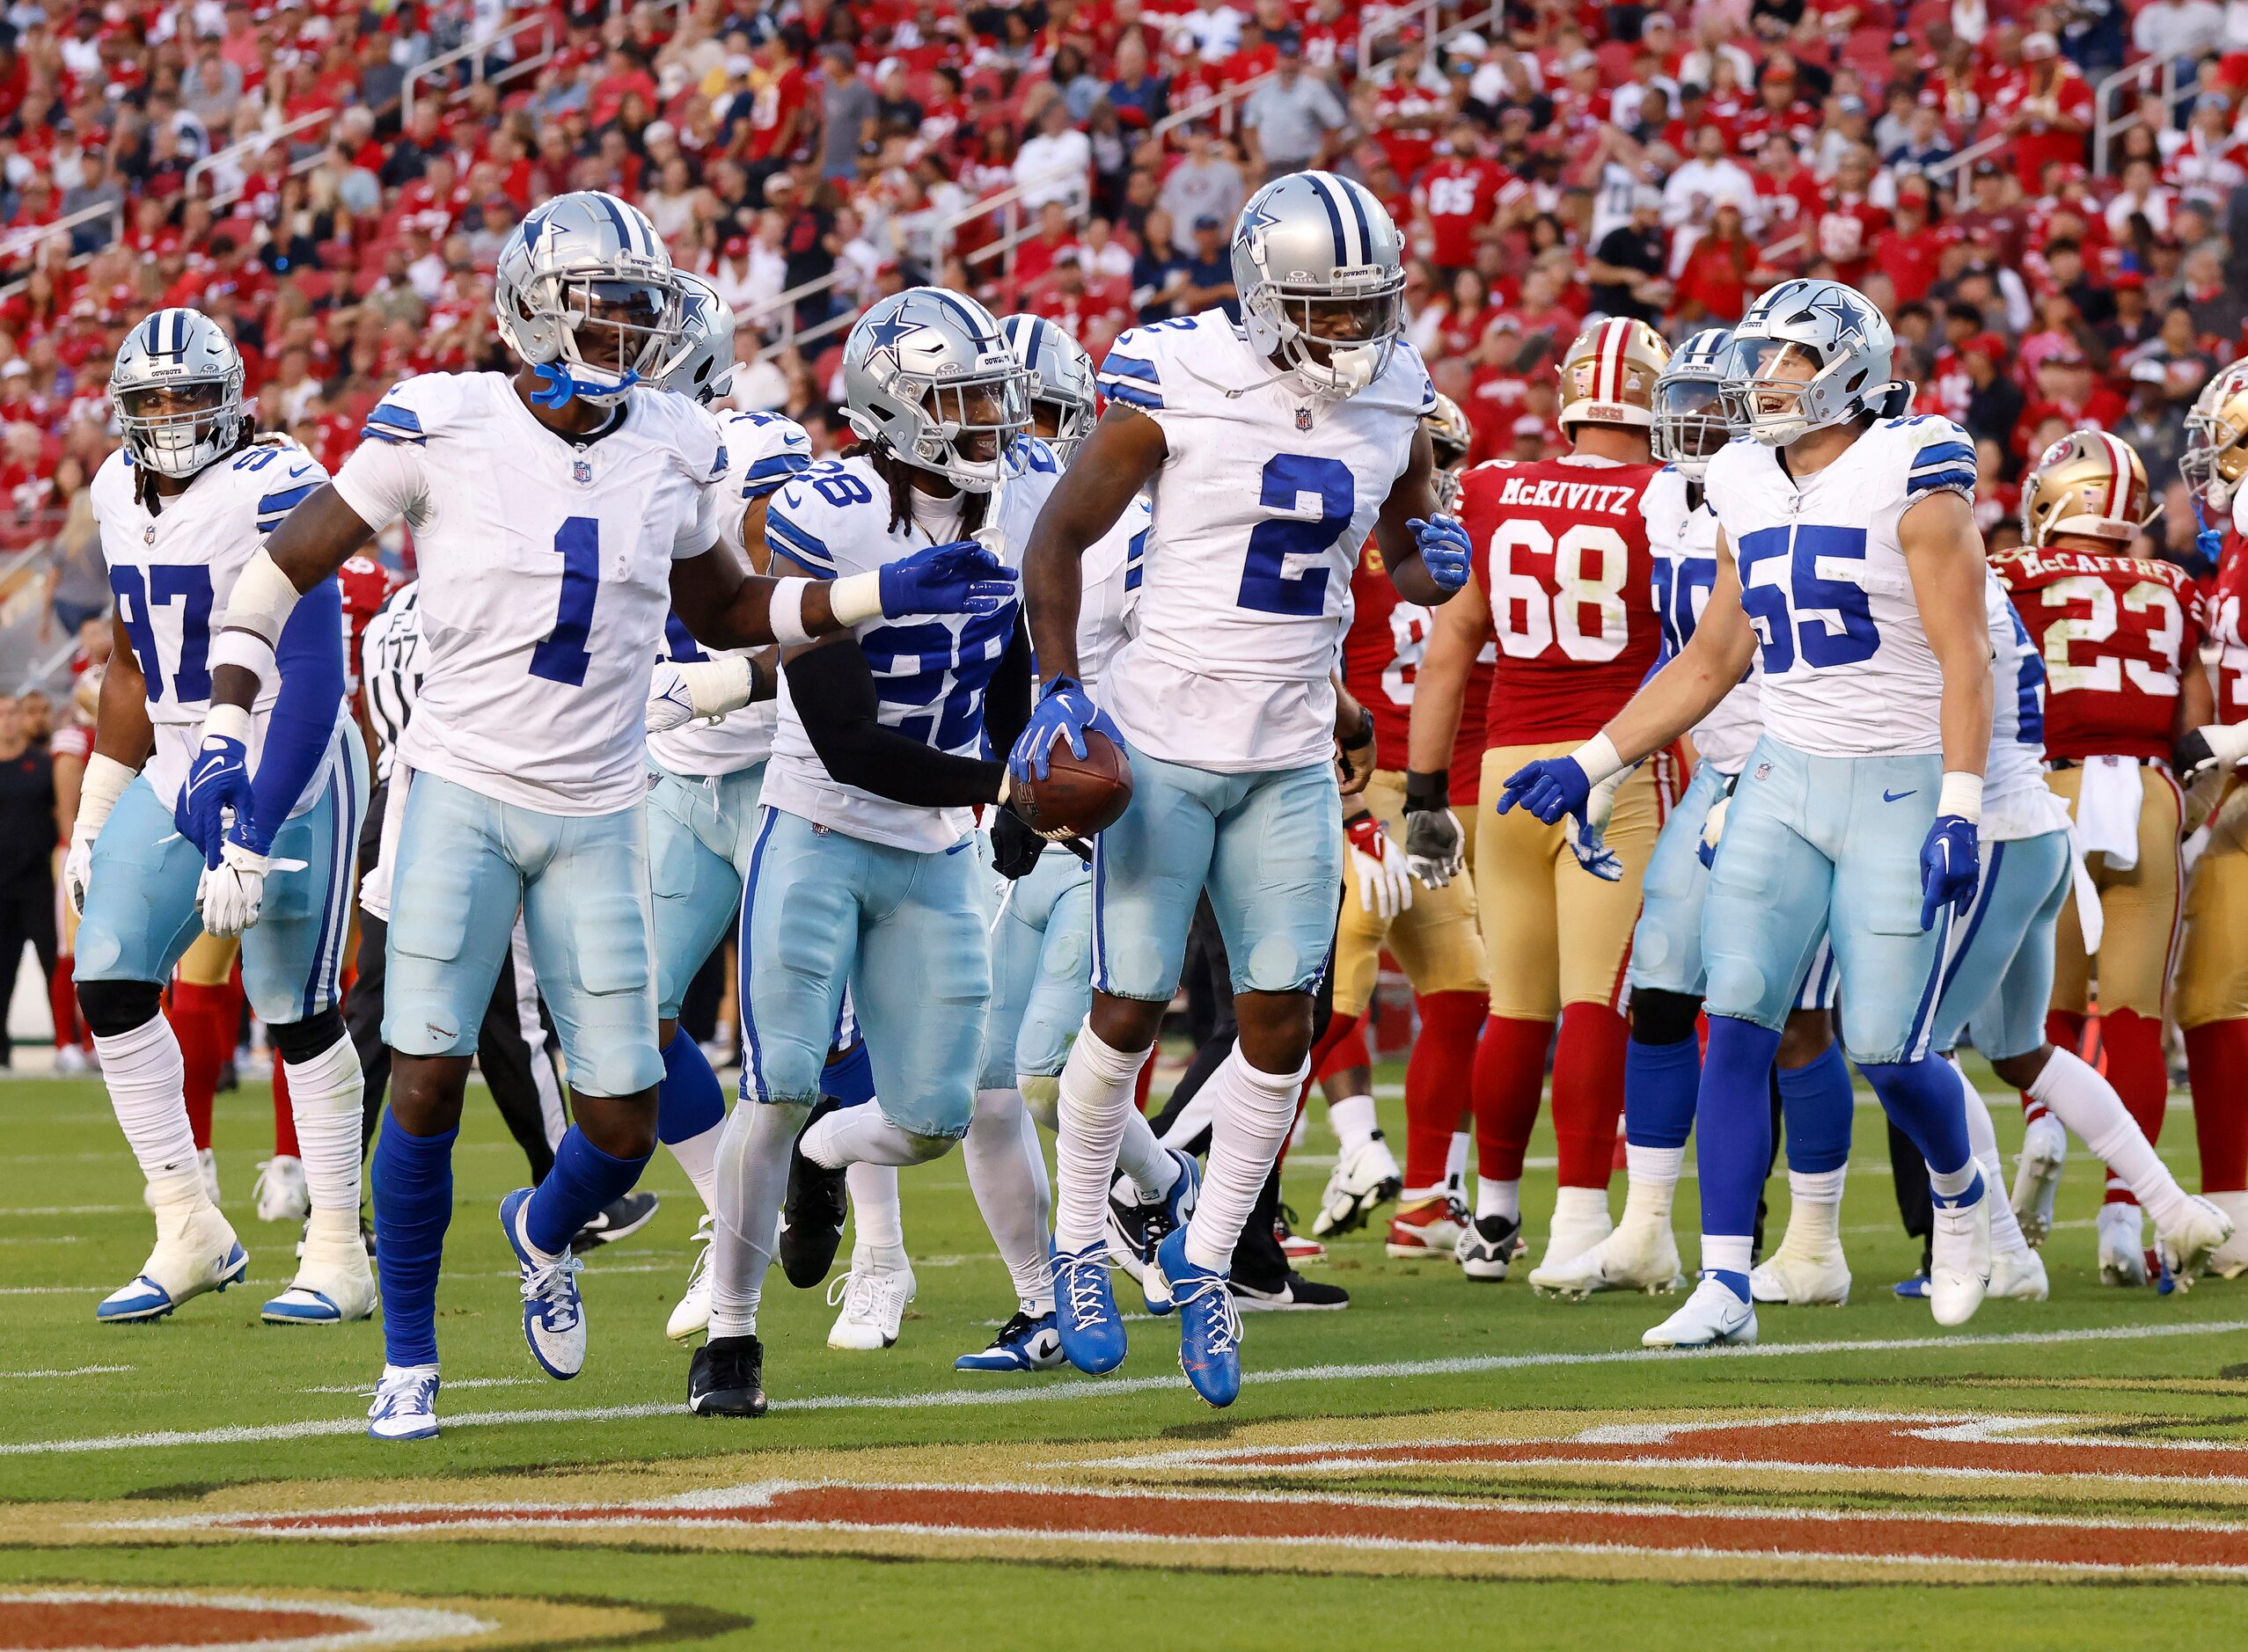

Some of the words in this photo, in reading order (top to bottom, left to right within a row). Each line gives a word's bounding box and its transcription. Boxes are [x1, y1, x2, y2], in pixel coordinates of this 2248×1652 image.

[1236, 453, 1355, 617] 2
[1498, 477, 1636, 516] McKIVITZ
[109, 564, 215, 704] 97
[390, 612, 417, 633] FJ
[529, 515, 599, 687] 1
[1488, 518, 1629, 662] 68
[1738, 524, 1881, 675] 55
[2017, 549, 2187, 594] McCAFFREY
[2042, 575, 2183, 697] 23
[860, 596, 1021, 753] 28
